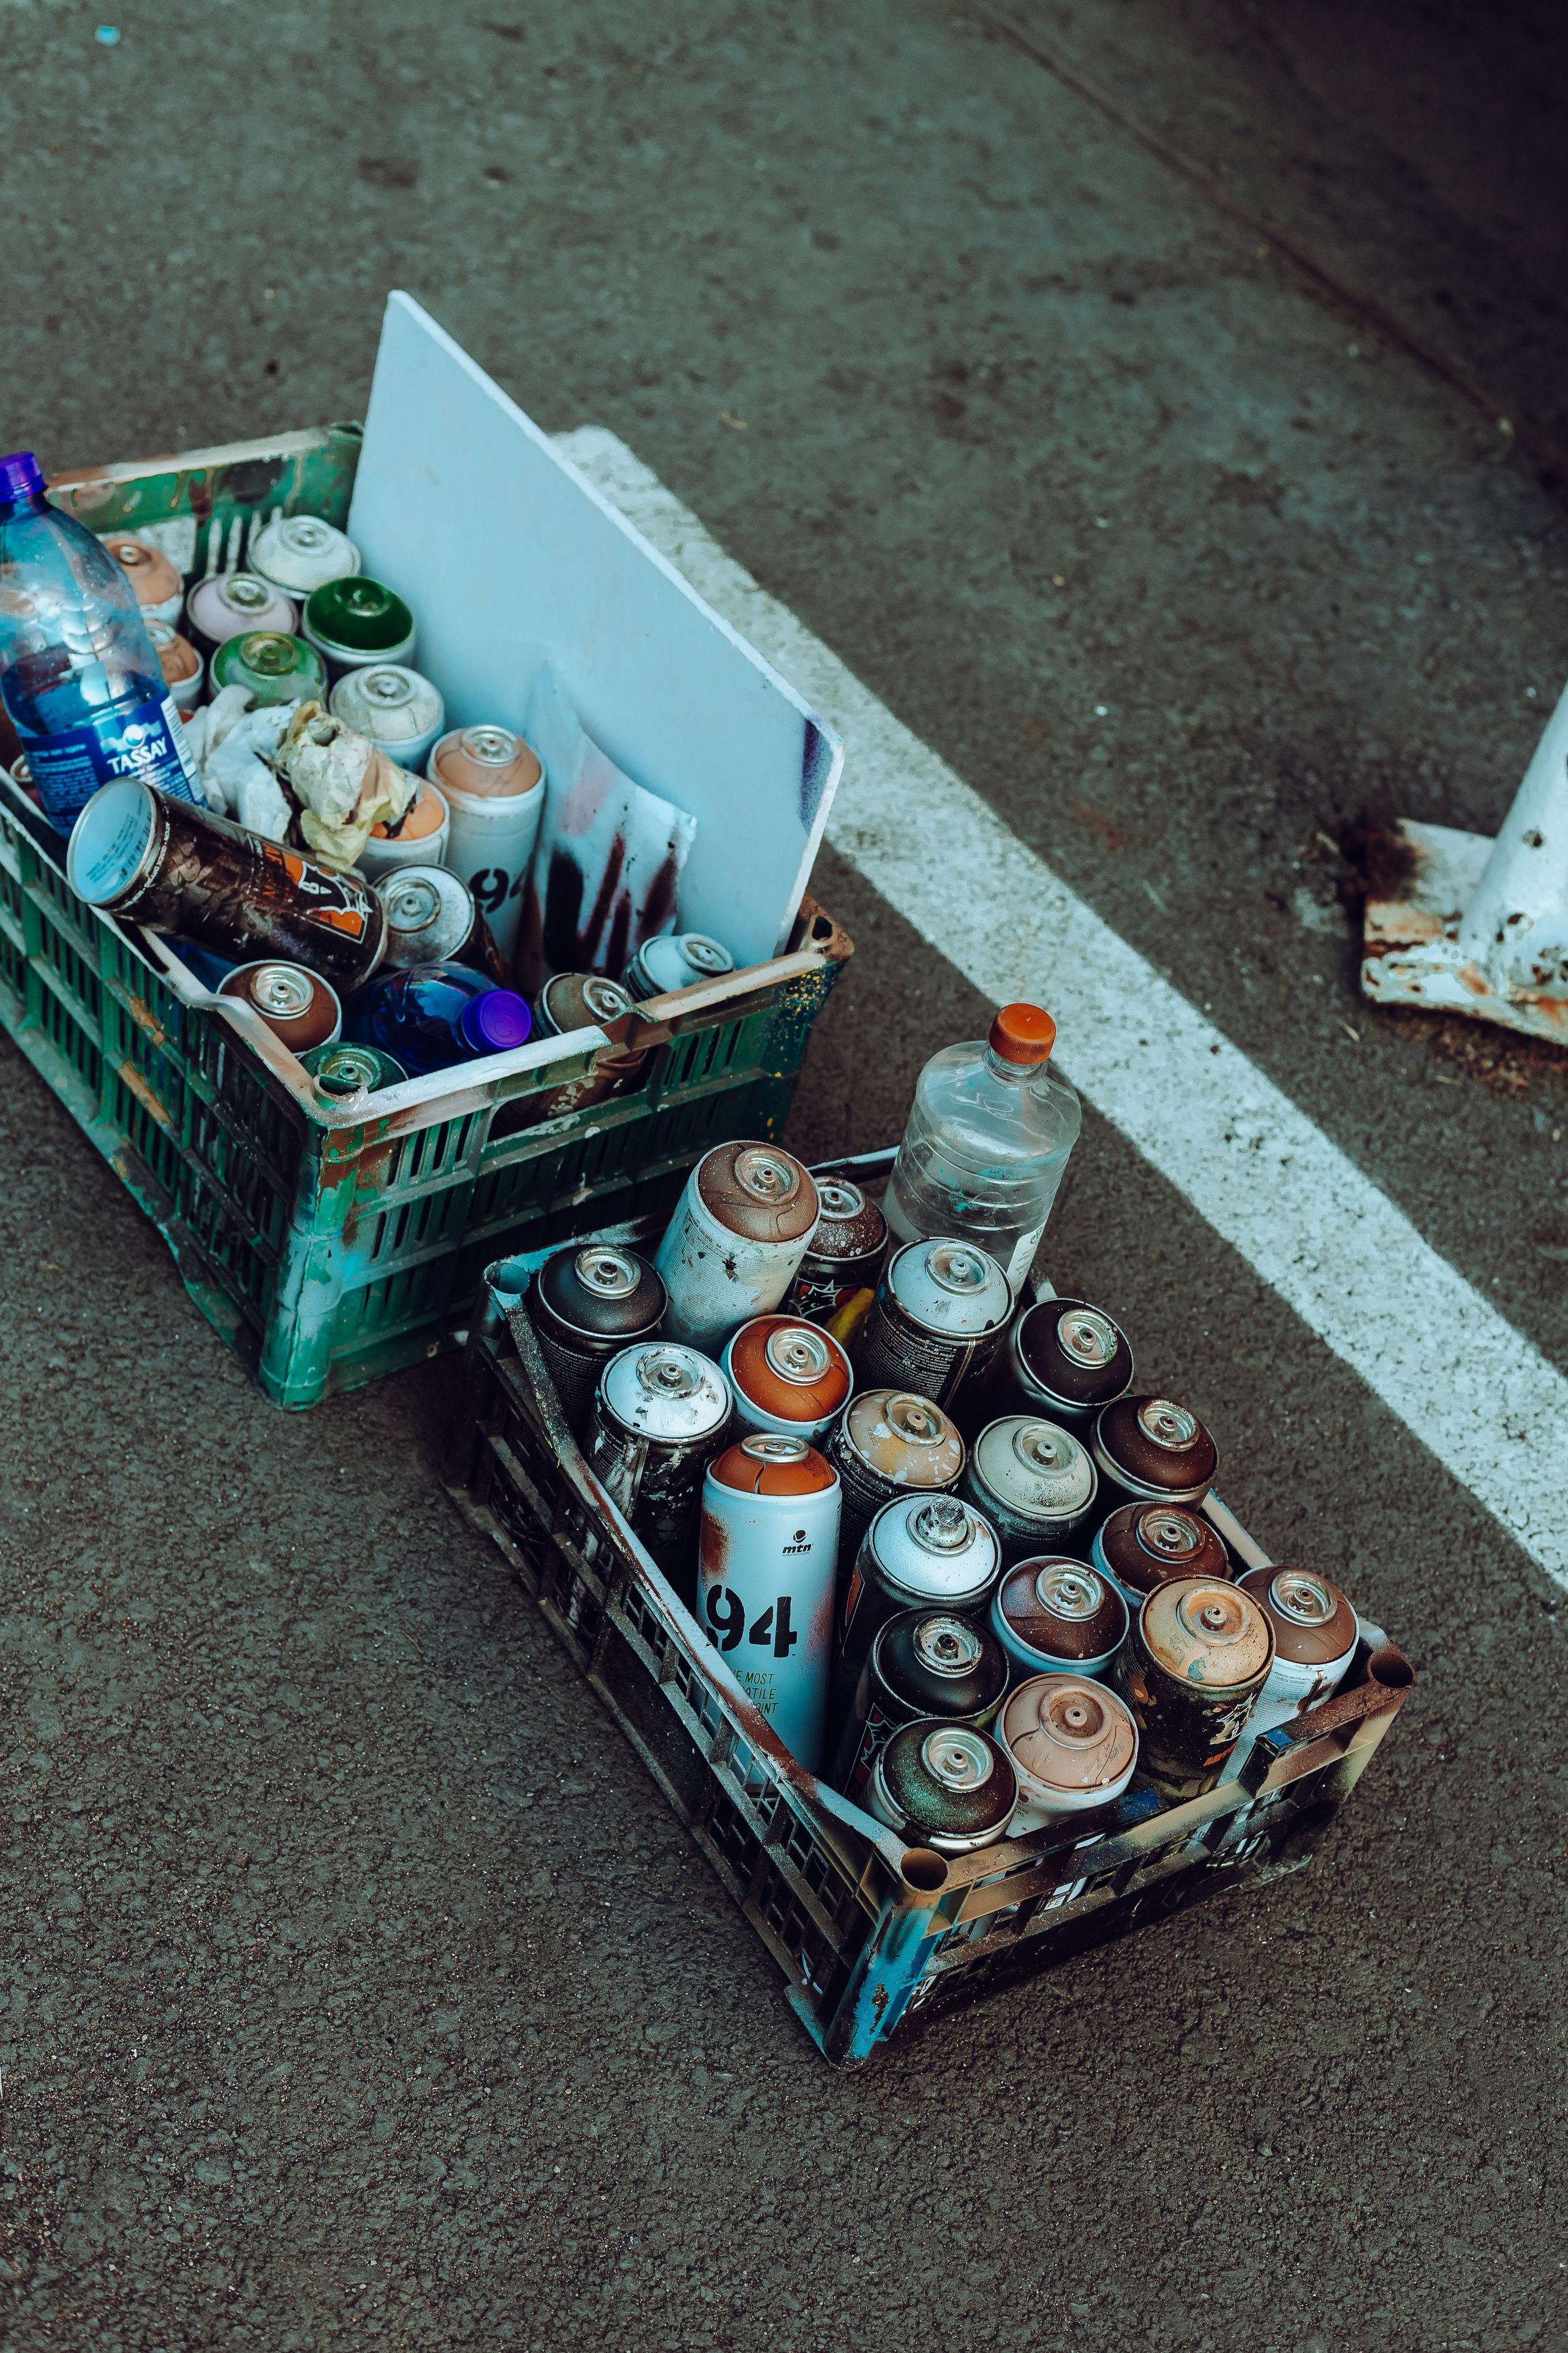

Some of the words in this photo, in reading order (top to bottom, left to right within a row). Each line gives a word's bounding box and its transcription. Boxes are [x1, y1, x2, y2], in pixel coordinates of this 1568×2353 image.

[106, 736, 167, 774] TASSAY
[782, 1543, 812, 1554] mtn
[706, 1584, 797, 1658] 94
[745, 1671, 776, 1685] MOST
[742, 1686, 776, 1700] ATILE
